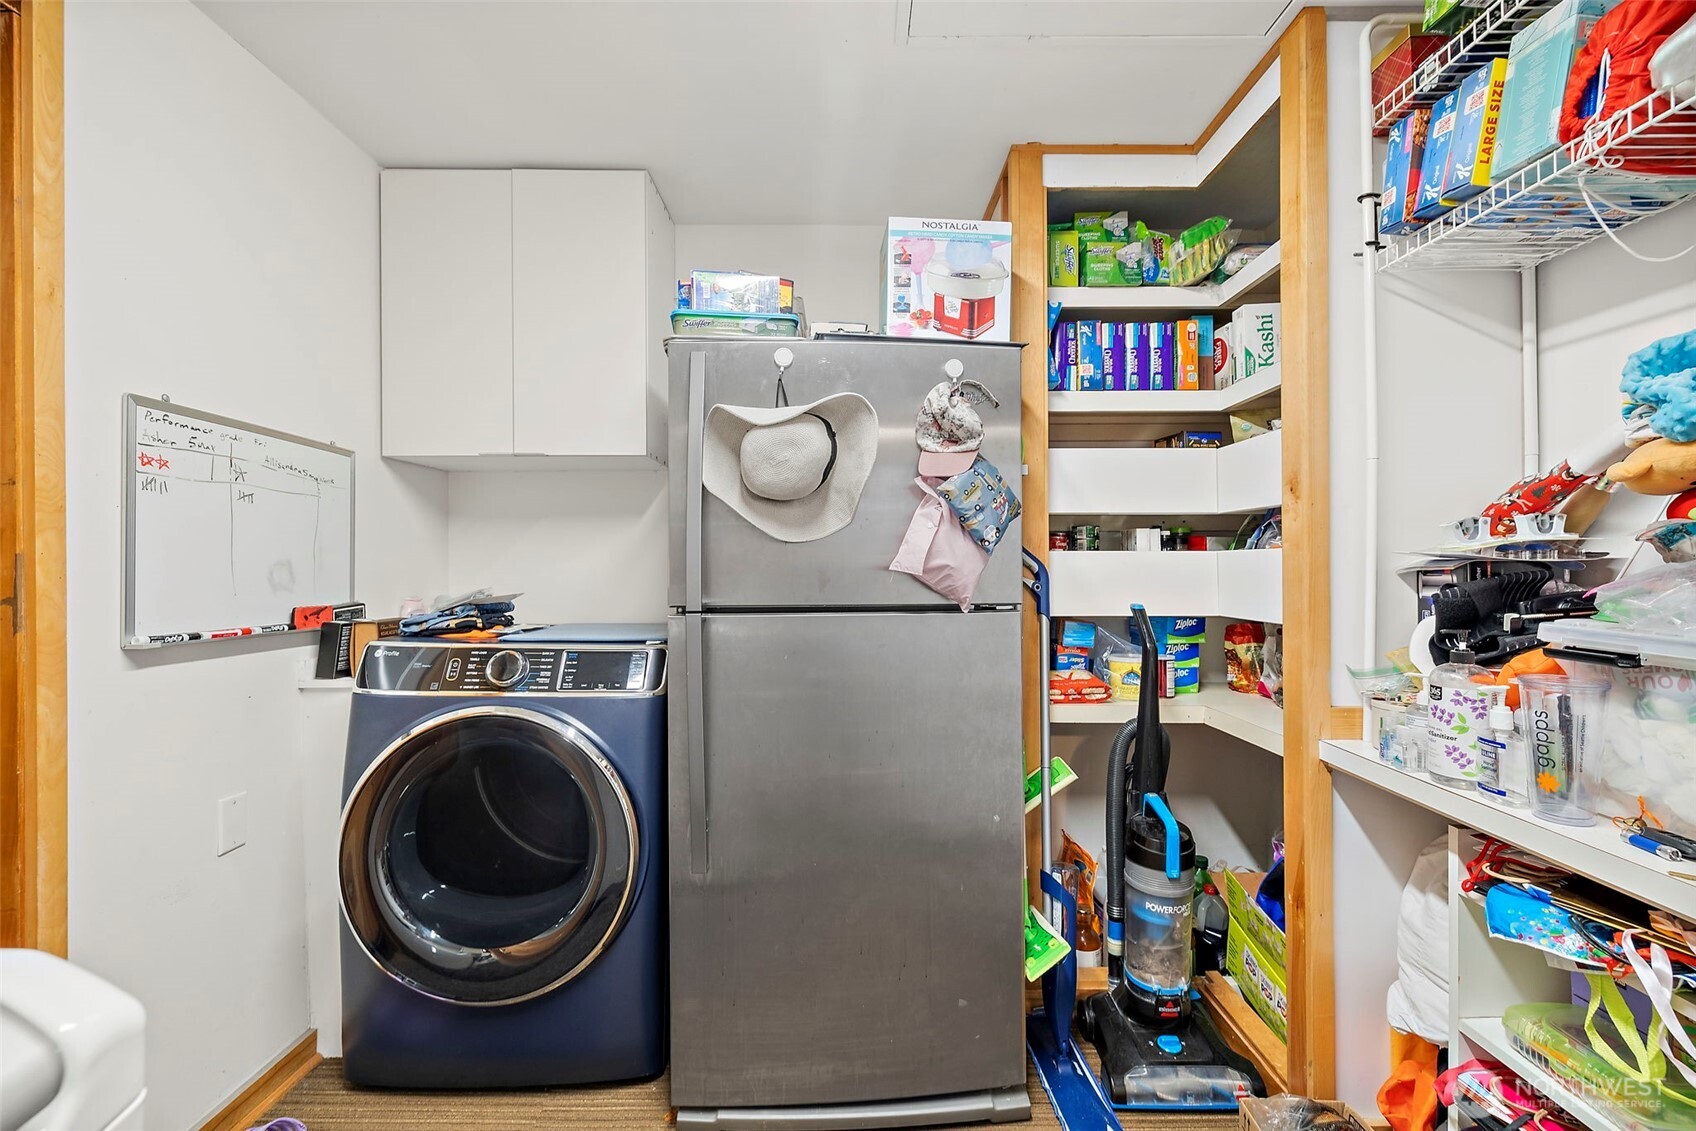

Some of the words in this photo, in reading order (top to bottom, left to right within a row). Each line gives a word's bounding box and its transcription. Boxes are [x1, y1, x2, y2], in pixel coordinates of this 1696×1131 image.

[1480, 116, 1498, 165] LARGE
[1490, 80, 1505, 112] SIZE
[922, 221, 979, 231] NOSTALGIA
[682, 319, 711, 328] Swiffer
[1257, 314, 1275, 368] Kashi
[144, 410, 214, 434] Performance
[1174, 618, 1198, 630] Ziploc
[1165, 643, 1190, 655] Ziploc
[1174, 668, 1190, 680] ploc
[1534, 710, 1556, 769] gapps
